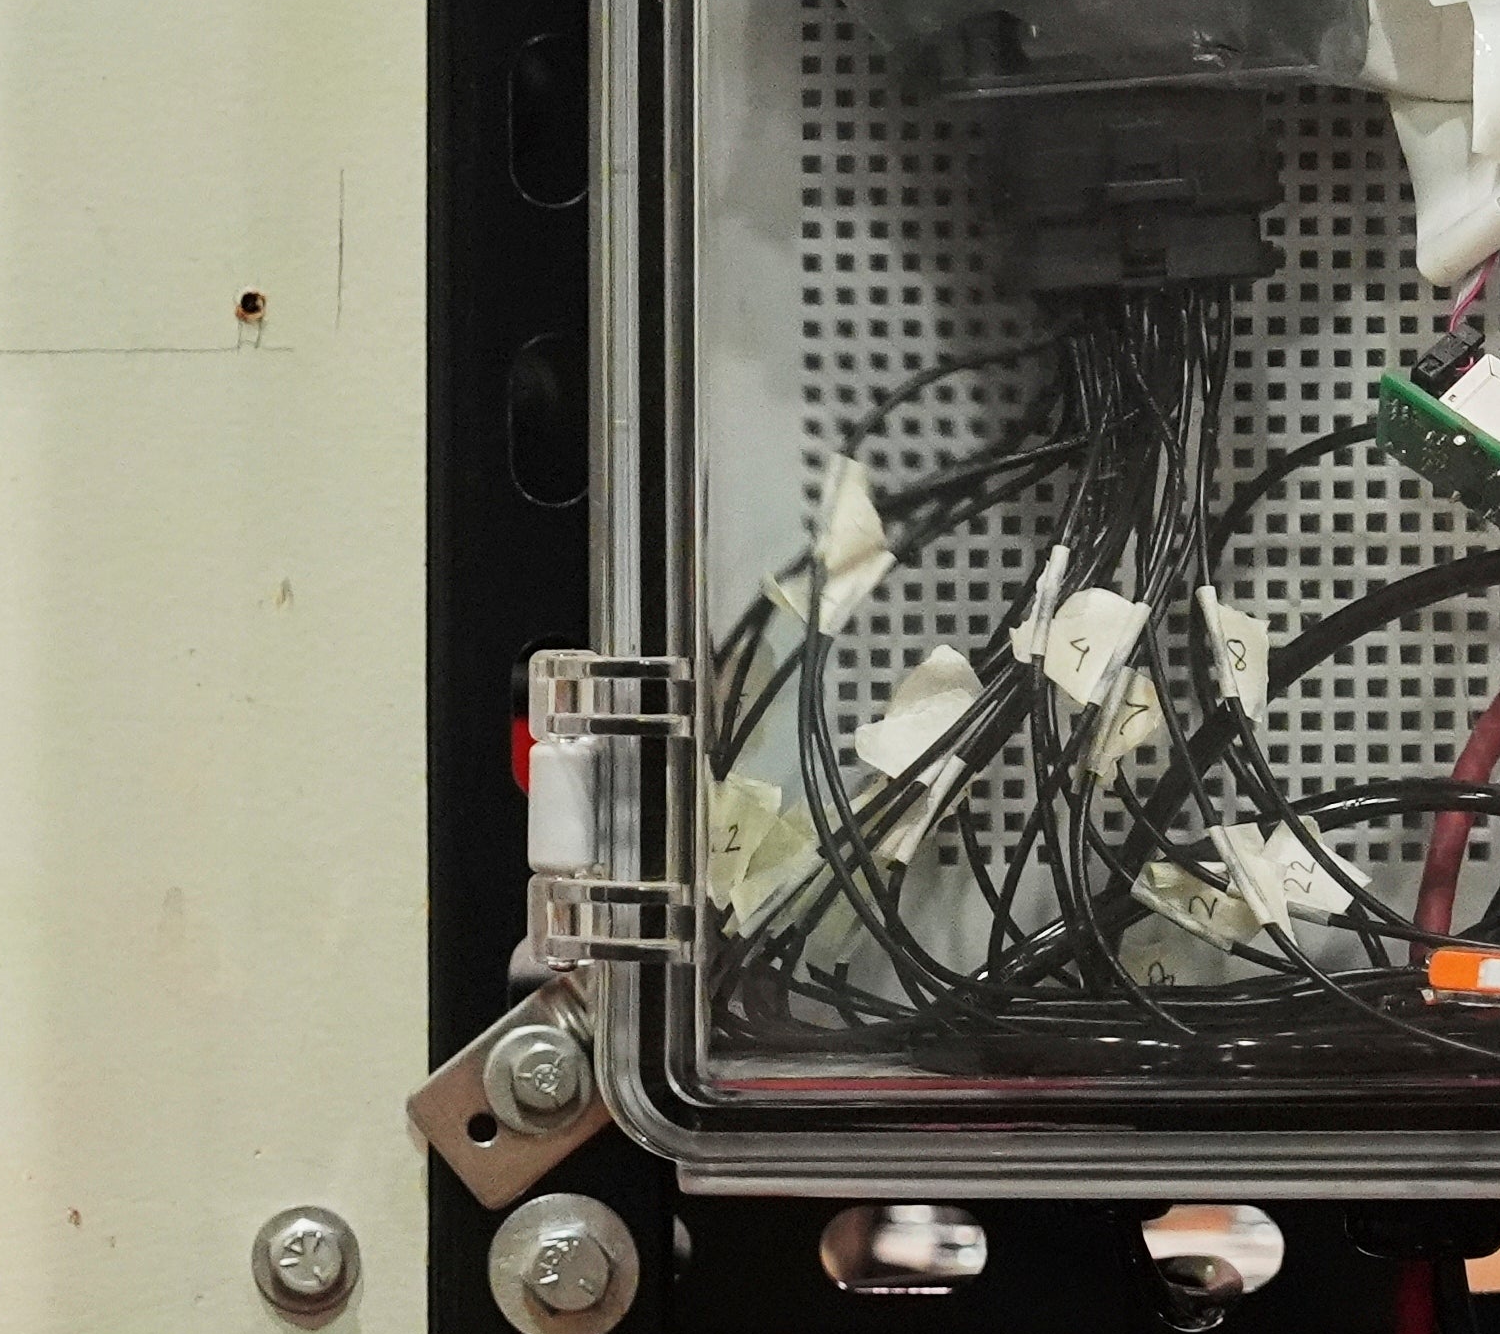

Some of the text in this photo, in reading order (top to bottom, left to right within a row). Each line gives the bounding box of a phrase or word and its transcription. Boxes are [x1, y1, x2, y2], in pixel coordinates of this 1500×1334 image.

[1069, 636, 1091, 673] 4
[1226, 638, 1248, 672] 8
[1282, 859, 1317, 895] 22
